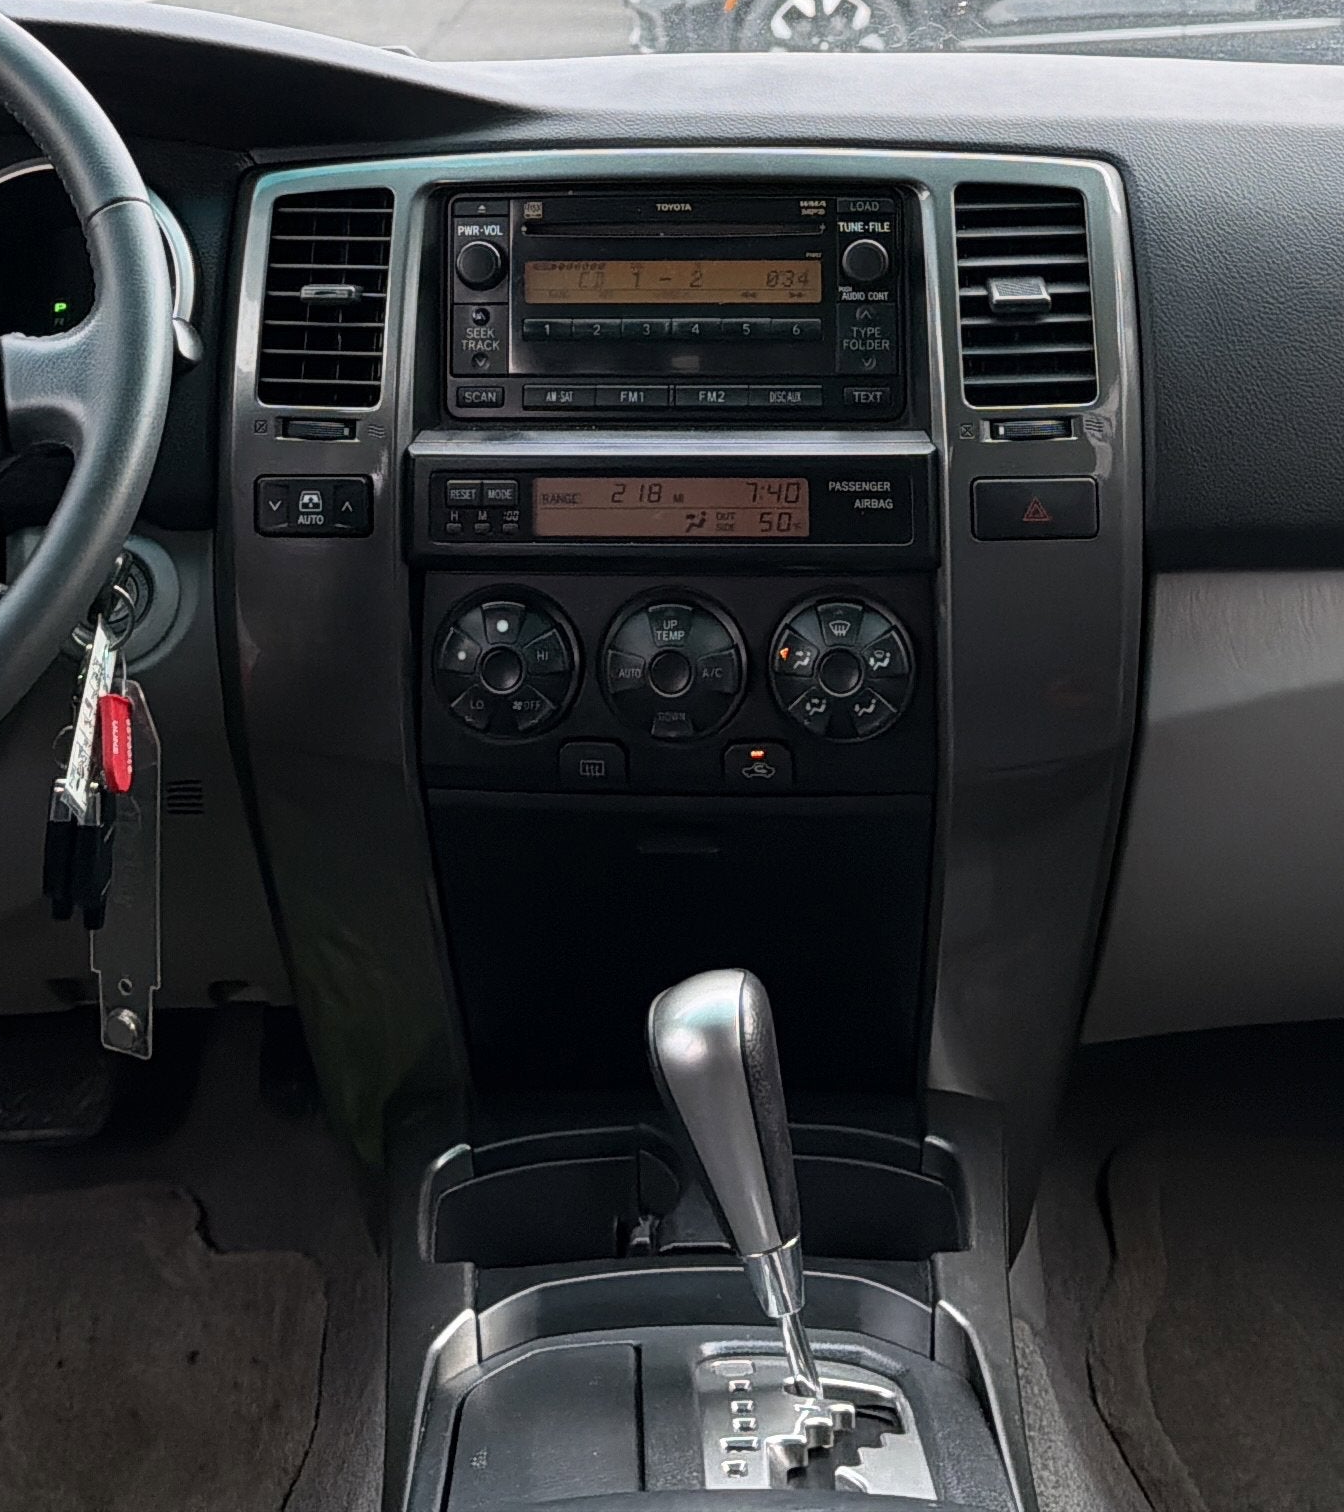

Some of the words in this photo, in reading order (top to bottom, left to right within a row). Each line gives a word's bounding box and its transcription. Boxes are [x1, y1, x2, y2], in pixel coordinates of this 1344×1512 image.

[656, 203, 692, 211] TOYOTA
[850, 202, 880, 211] LOAD
[689, 270, 703, 288] 2
[841, 292, 865, 301] AUDIO
[868, 292, 888, 301] CONT
[54, 302, 66, 312] P
[466, 328, 495, 338] SEEK
[593, 324, 601, 335] 2
[643, 324, 650, 335] 3
[691, 324, 700, 335] 4
[743, 324, 750, 335] 5
[792, 324, 800, 335] 6
[851, 327, 881, 338] TYPE
[461, 340, 500, 351] TRACK
[843, 339, 889, 351] FOLDER
[464, 391, 496, 402] SCAN
[620, 391, 644, 402] FM1
[699, 391, 725, 402] FM2
[853, 391, 882, 402] TEXT
[828, 481, 891, 491] PASSENGER
[450, 490, 476, 500] RESET
[487, 490, 513, 499] MODE
[542, 493, 580, 504] RANGE
[611, 483, 663, 503] 218
[746, 482, 801, 503] 7:40
[854, 499, 894, 509] AIRBAG
[297, 515, 324, 525] AUTO
[450, 511, 459, 521] H
[478, 511, 488, 521] M
[663, 620, 678, 630] UP
[656, 630, 685, 641] TEMP
[536, 650, 549, 662] HI
[618, 668, 641, 678] AUTO
[702, 668, 723, 679] A/C
[470, 700, 484, 710] LO
[523, 700, 541, 711] OFF
[658, 712, 686, 721] DOWN
